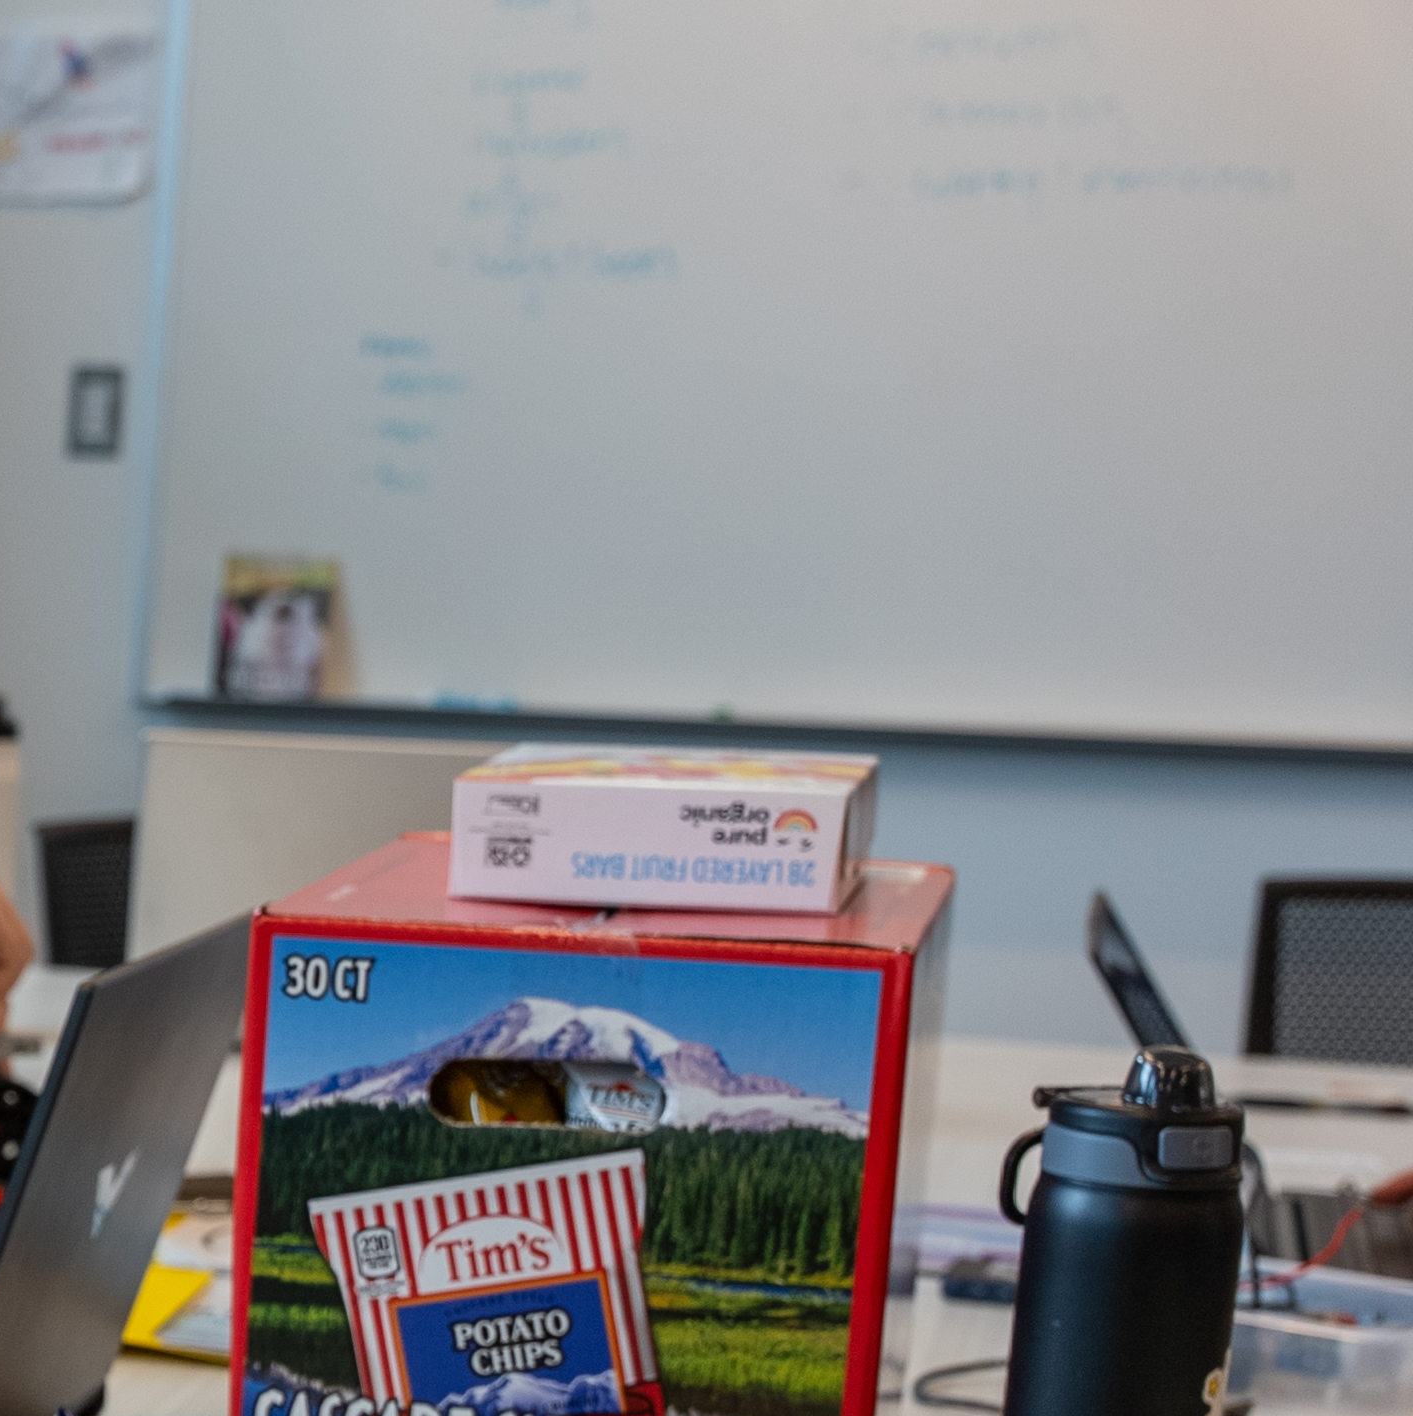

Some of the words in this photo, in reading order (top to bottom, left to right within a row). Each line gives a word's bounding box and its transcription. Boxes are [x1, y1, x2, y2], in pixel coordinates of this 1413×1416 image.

[680, 801, 770, 828] organic
[712, 827, 767, 845] pure
[571, 851, 625, 880] BARS
[631, 854, 687, 882] FRUIT
[691, 857, 784, 886] LAYERED
[788, 860, 815, 887] 28
[282, 955, 329, 1000] 30
[332, 957, 375, 1003] CT
[436, 1232, 552, 1282] Tim's
[452, 1308, 570, 1350] POTATO
[470, 1339, 564, 1376] CHIPS
